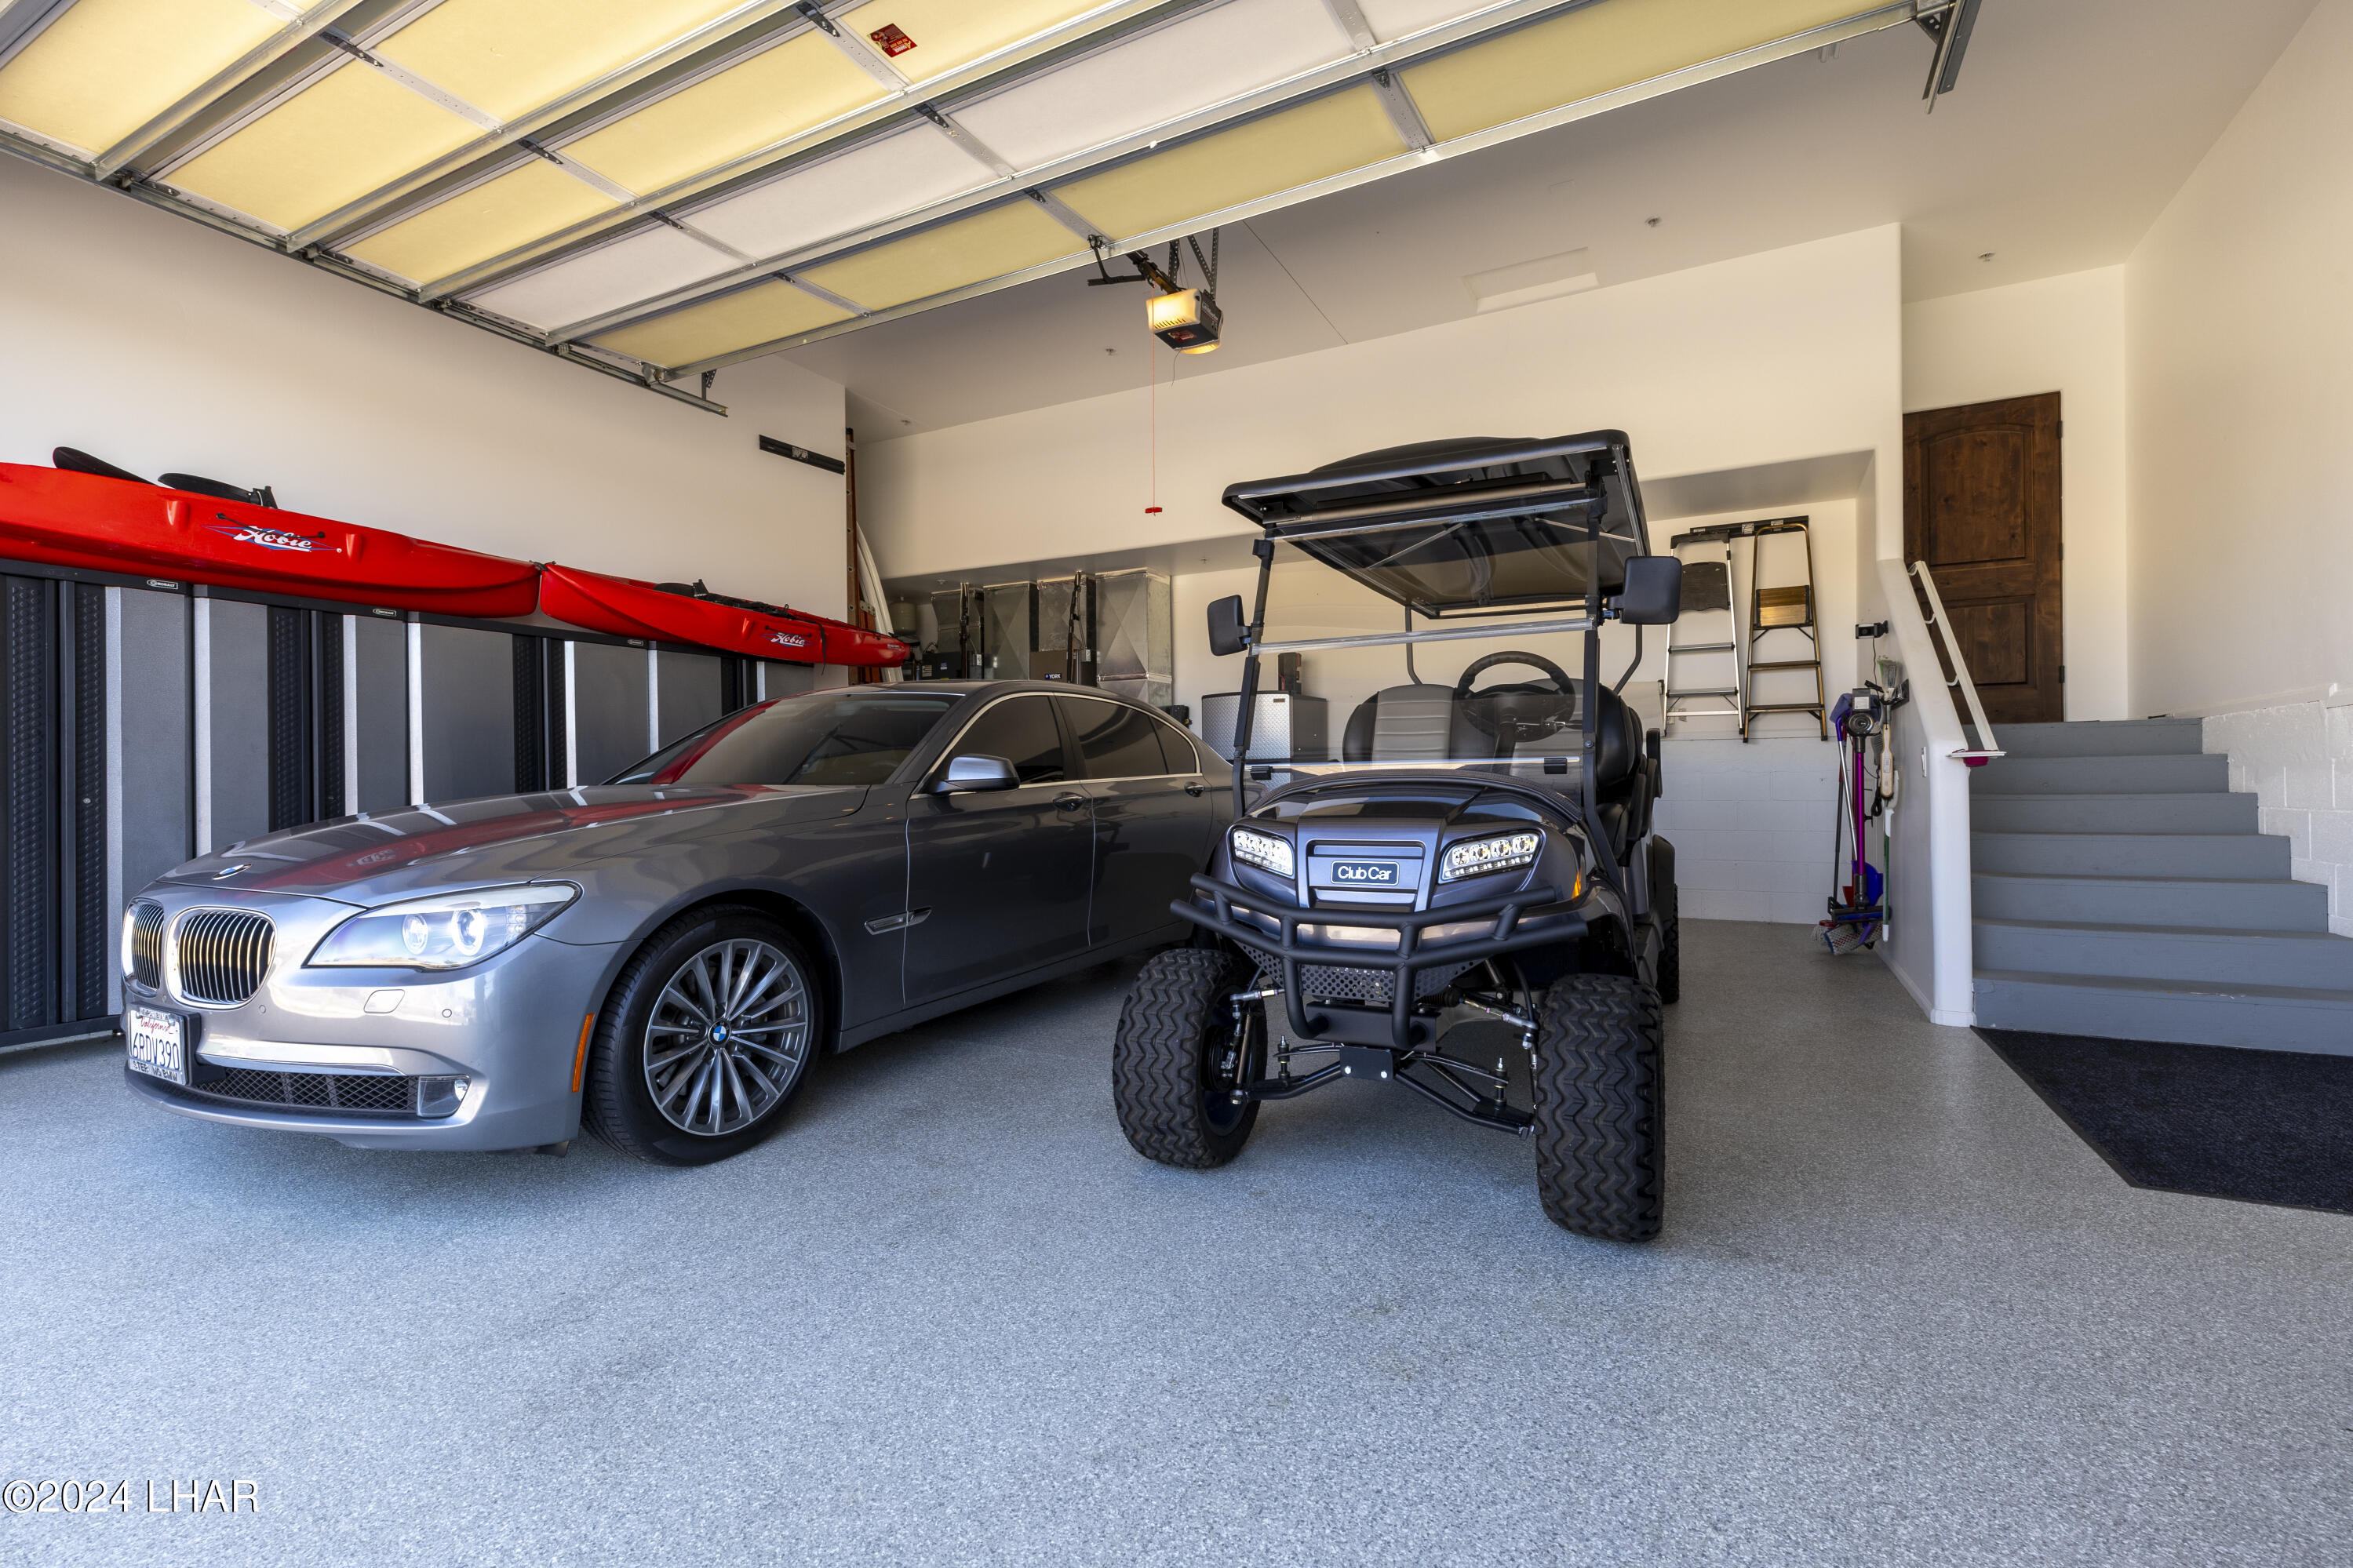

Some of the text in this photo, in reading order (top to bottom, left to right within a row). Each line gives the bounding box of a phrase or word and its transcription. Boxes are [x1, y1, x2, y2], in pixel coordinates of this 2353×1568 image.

[233, 526, 312, 552] Hobie
[770, 631, 805, 647] Hobie
[1337, 865, 1392, 880] Club Car
[133, 1032, 180, 1071] 6RDV390
